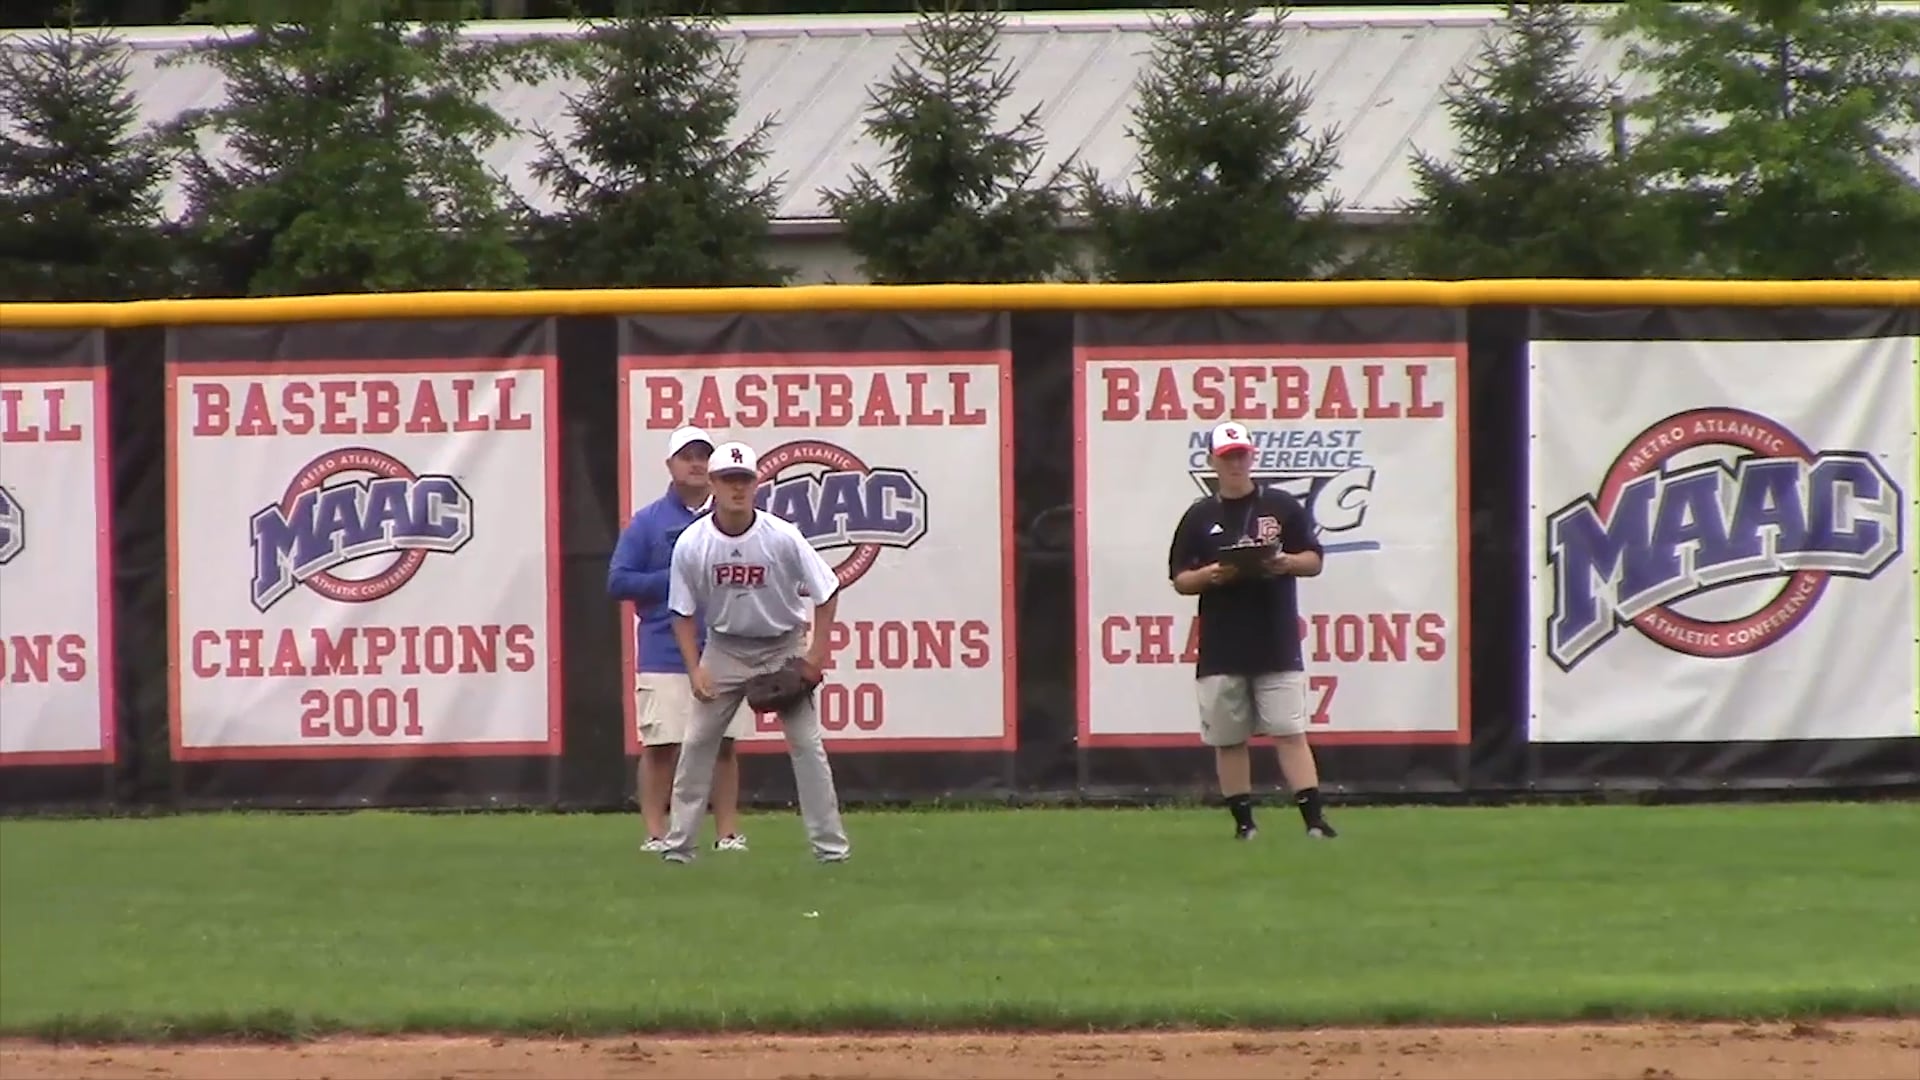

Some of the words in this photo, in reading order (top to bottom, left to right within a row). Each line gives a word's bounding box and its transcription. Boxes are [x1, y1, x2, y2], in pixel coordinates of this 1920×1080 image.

[193, 377, 531, 437] BASEBALL
[645, 372, 987, 429] BASEBALL
[1101, 365, 1444, 421] BASEBALL
[793, 447, 852, 468] ATLANTIC
[1188, 430, 1362, 449] NTHEAST
[1629, 427, 1686, 472] METRO
[1693, 419, 1786, 453] ATLANTIC
[300, 459, 336, 489] METRO
[340, 455, 399, 475] ATLANTIC
[250, 474, 474, 613] MAAC
[1547, 451, 1904, 672] MAAC
[311, 575, 359, 596] ATHLETIC
[361, 550, 419, 595] CONFERENCE
[1645, 611, 1720, 648] ATHLETIC
[1727, 573, 1817, 646] CONFERENCE
[192, 624, 535, 679] CHAMPIONS
[300, 688, 424, 738] 2001
